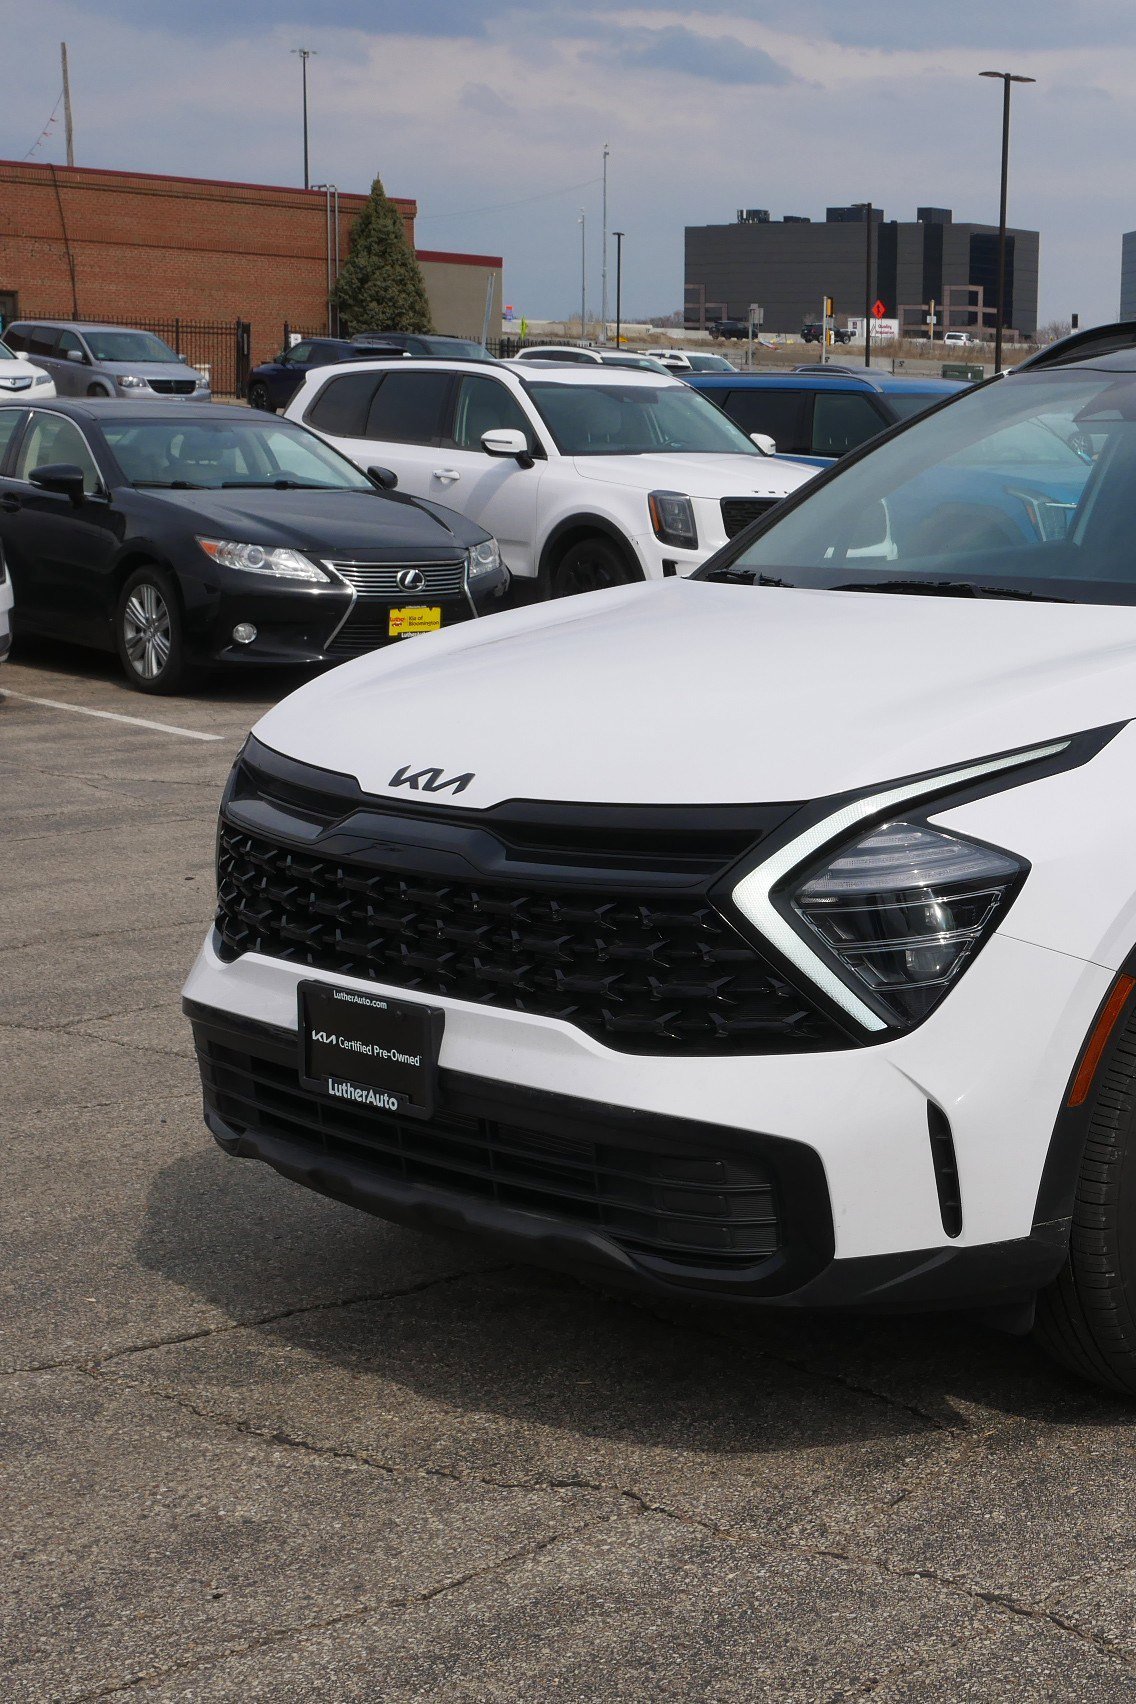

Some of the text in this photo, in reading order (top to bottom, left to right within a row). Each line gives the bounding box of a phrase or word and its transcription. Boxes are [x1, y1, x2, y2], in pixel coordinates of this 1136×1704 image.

[388, 764, 476, 796] KIA
[333, 989, 388, 1010] LutherAuto.com
[311, 1029, 421, 1067] KIA Certified Pre-Owned
[328, 1078, 398, 1111] LutherAuto
